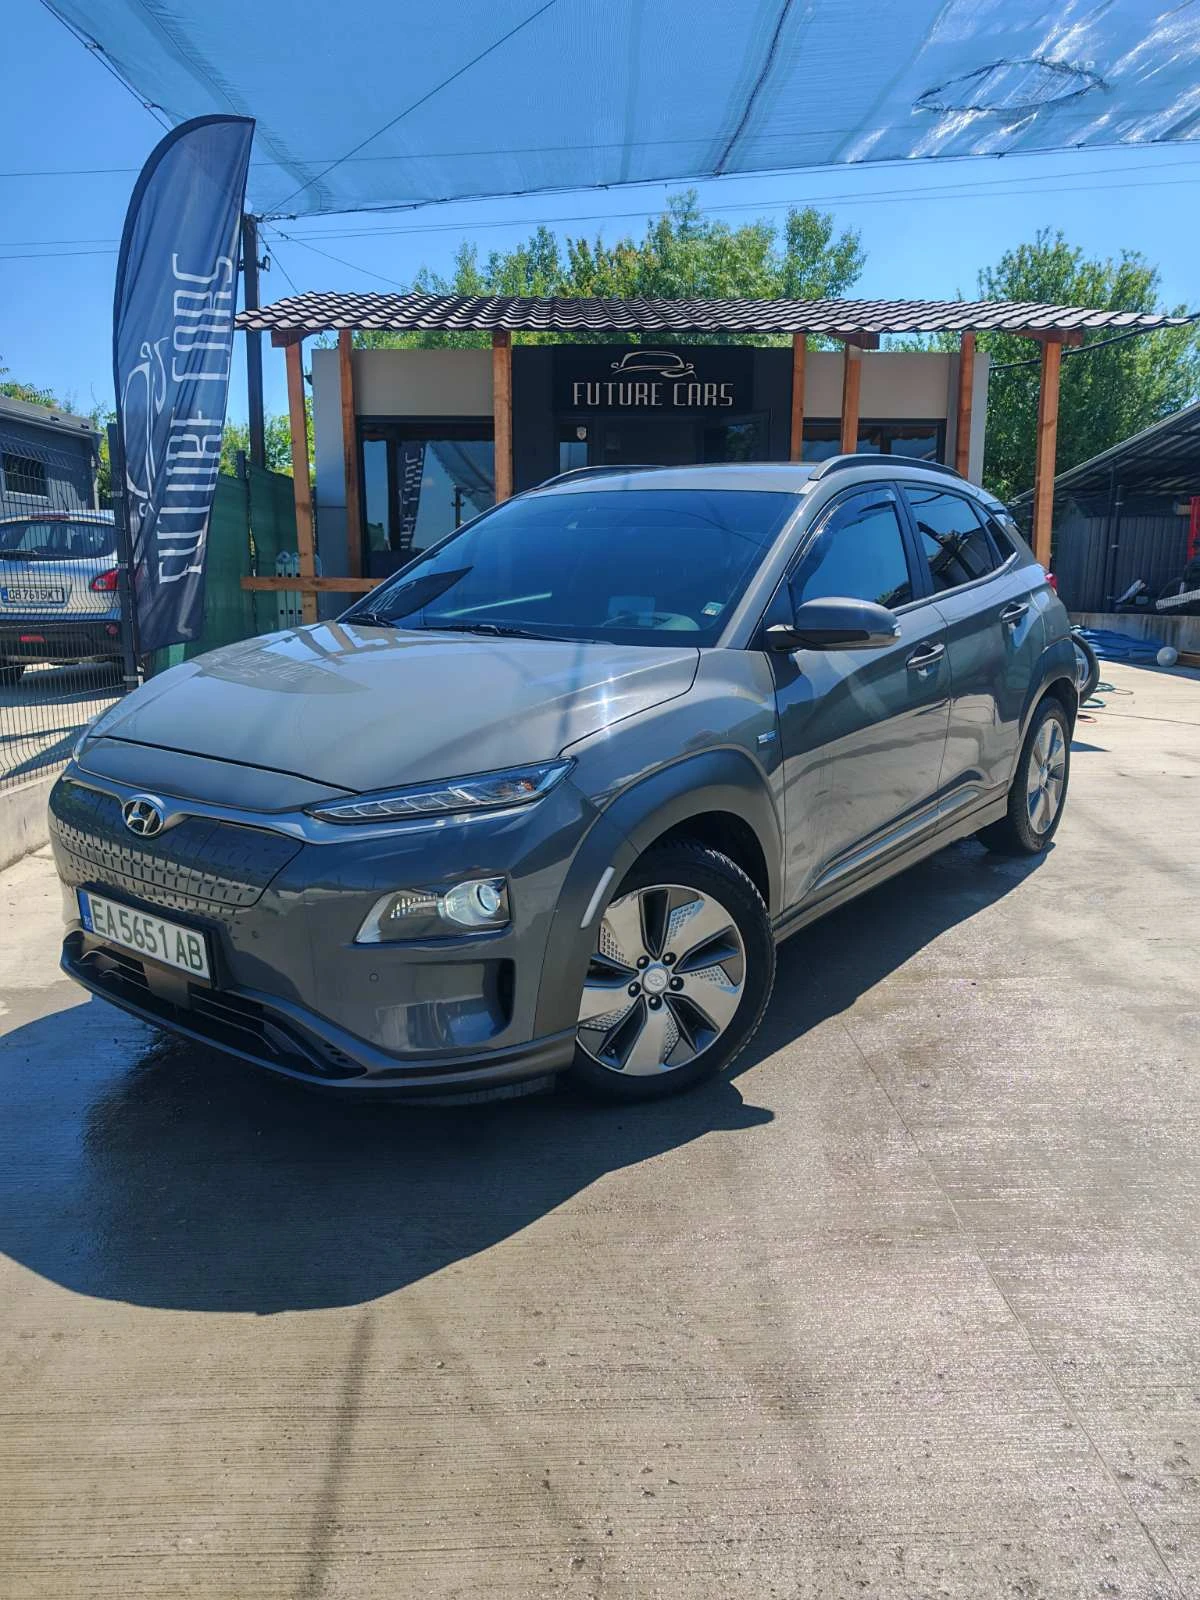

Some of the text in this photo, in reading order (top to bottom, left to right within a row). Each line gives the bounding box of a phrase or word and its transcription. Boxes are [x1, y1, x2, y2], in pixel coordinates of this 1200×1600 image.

[171, 253, 232, 382] CARS
[572, 382, 734, 406] FUTURE CARS
[118, 909, 169, 959] 5651
[176, 930, 203, 971] AB
